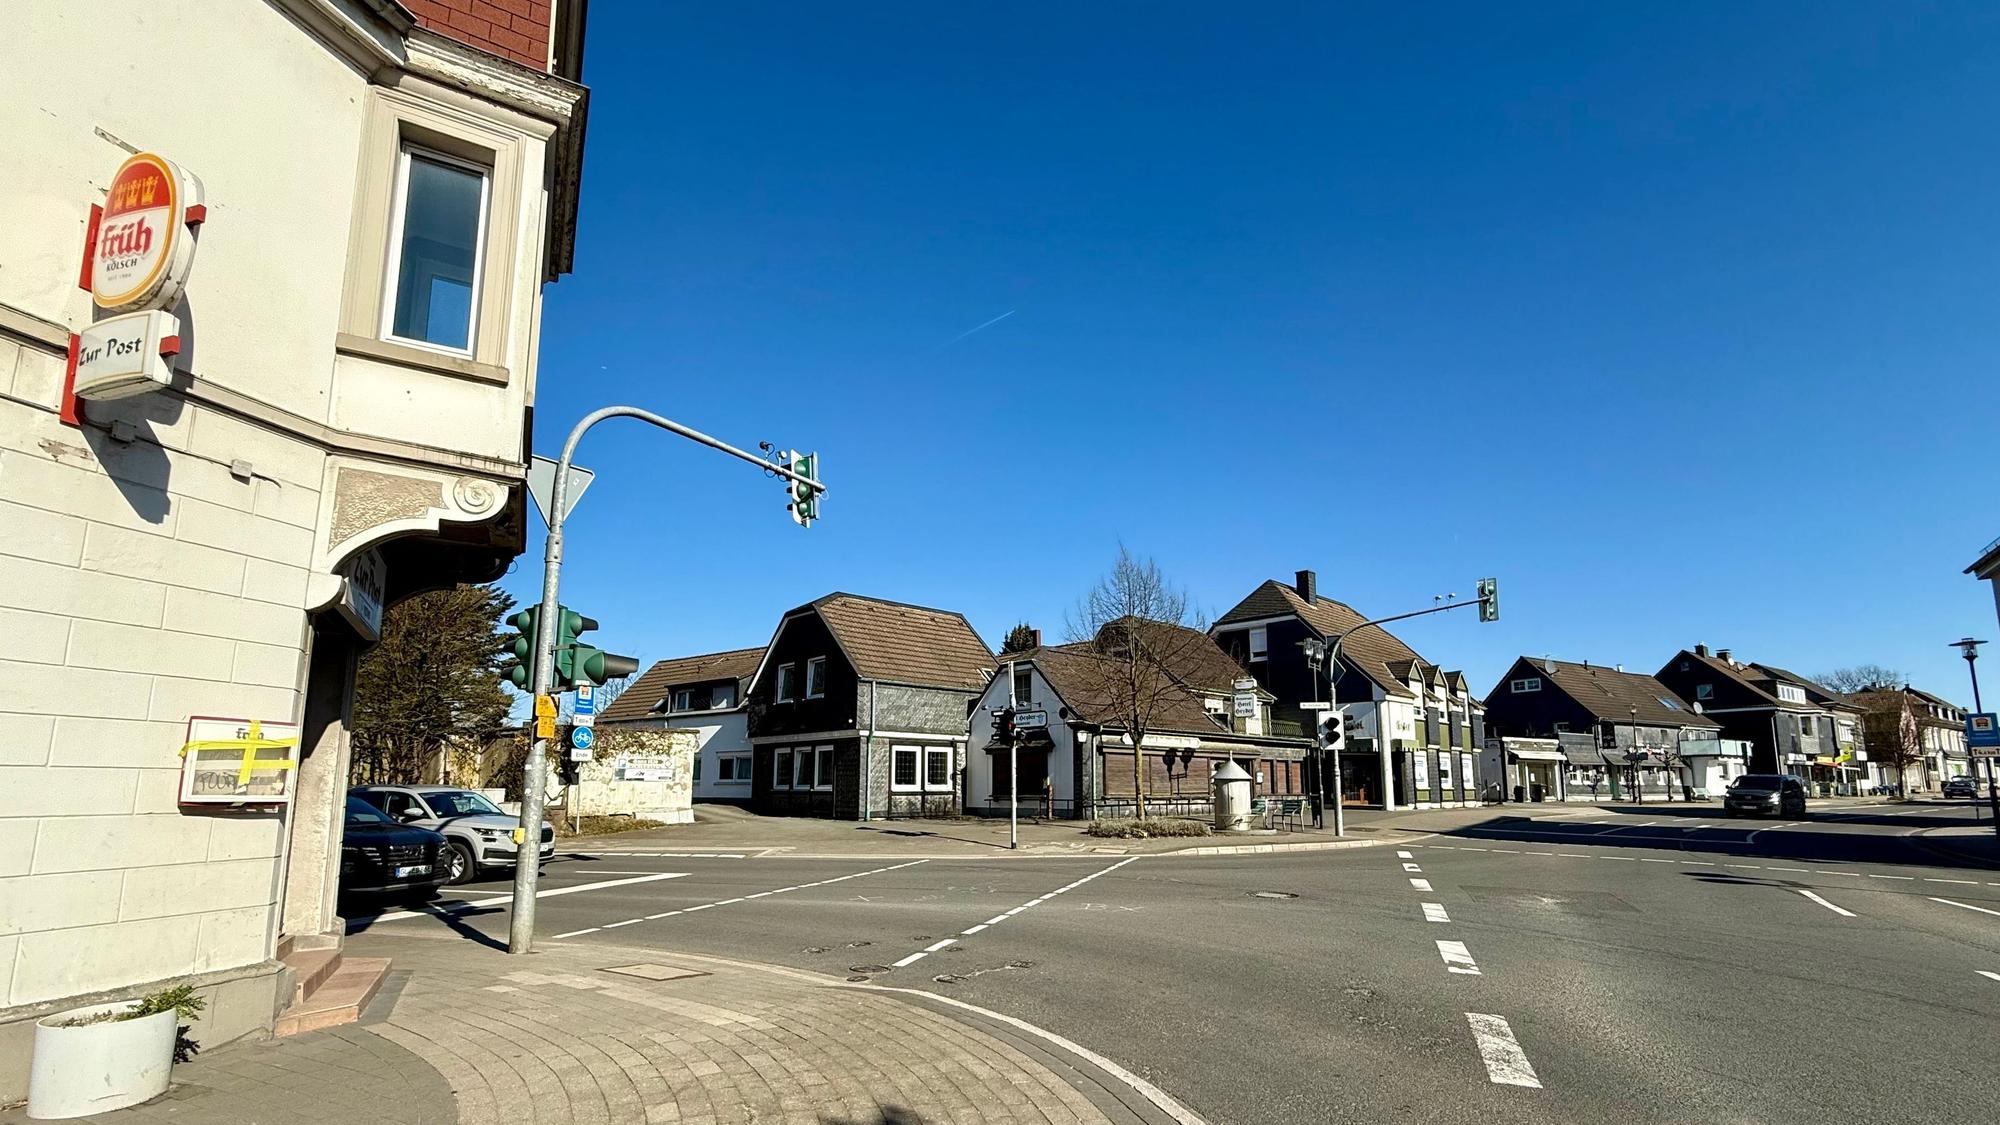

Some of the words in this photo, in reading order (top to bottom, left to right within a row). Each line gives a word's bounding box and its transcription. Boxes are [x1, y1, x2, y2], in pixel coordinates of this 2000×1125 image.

[101, 216, 152, 259] früh
[107, 258, 138, 272] KÖLSCH
[79, 346, 102, 367] Zur
[106, 337, 142, 357] Post
